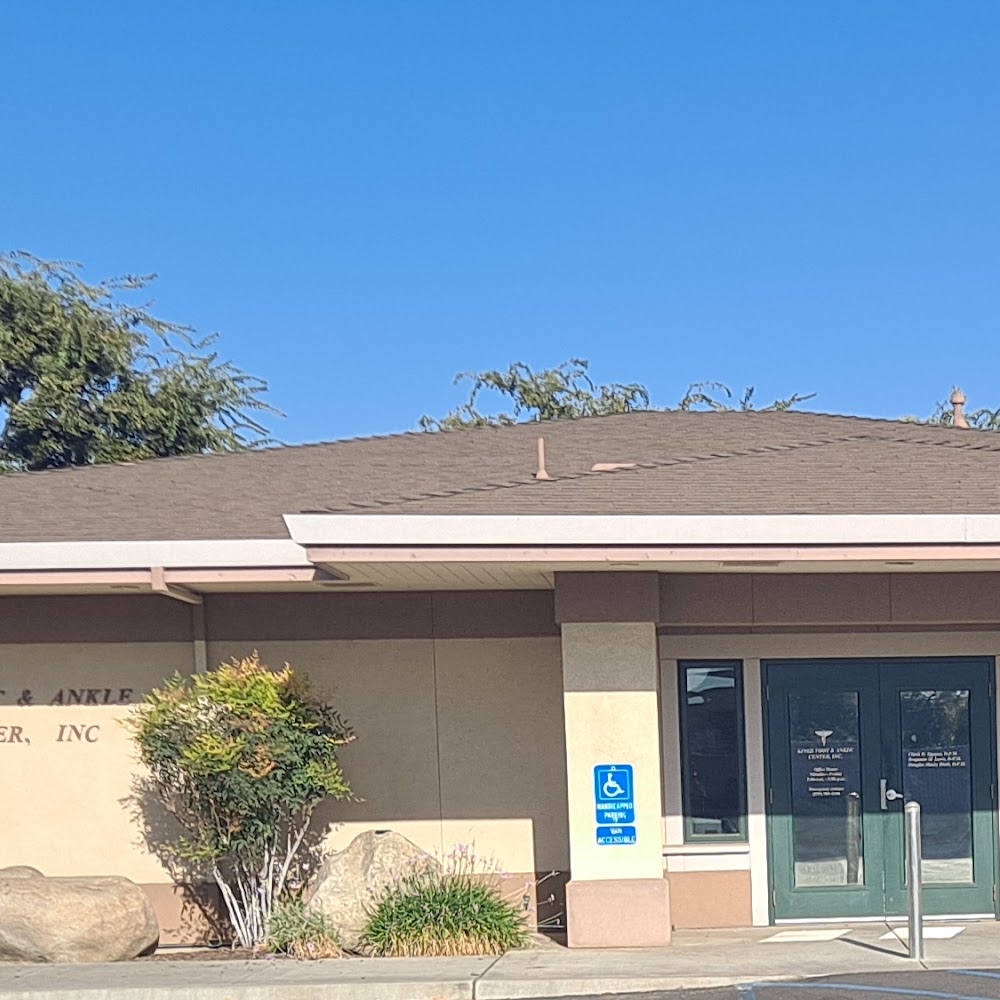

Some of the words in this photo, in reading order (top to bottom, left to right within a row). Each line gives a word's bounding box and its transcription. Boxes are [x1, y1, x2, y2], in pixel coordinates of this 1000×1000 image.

[17, 689, 33, 706] &
[49, 688, 133, 706] ANKLE
[56, 724, 100, 742] INC
[597, 835, 636, 844] ACCESSIBLE
